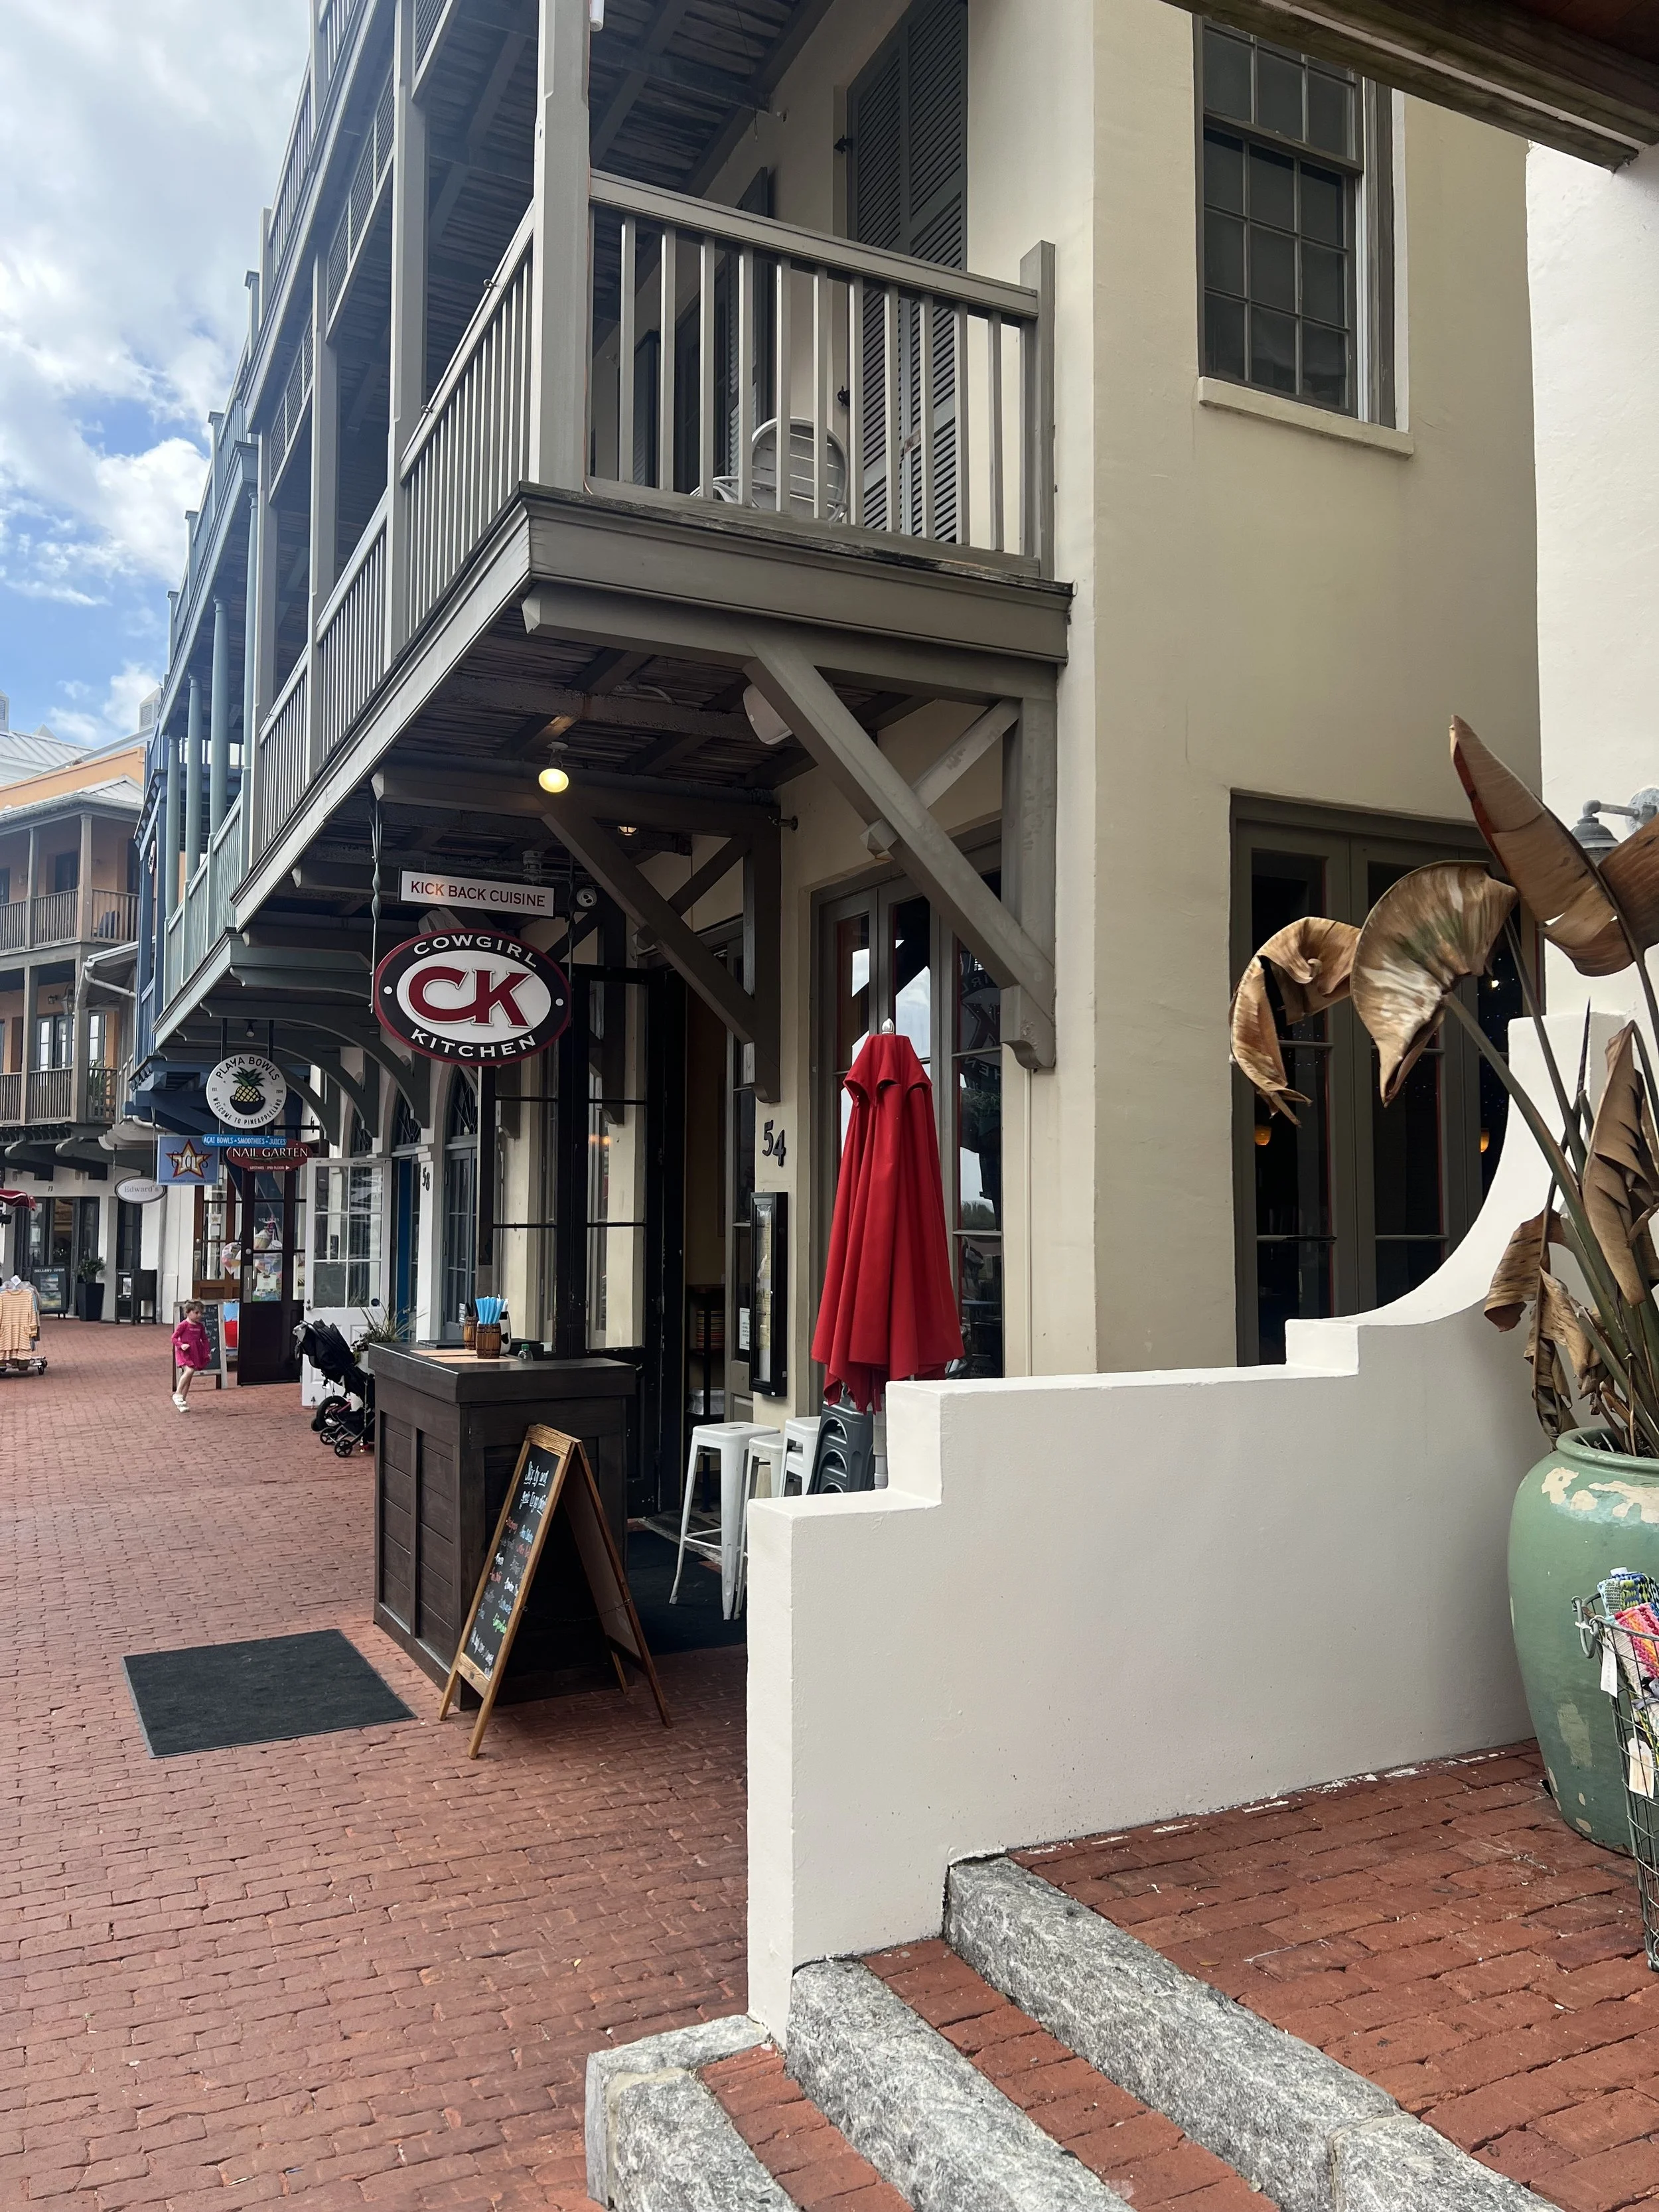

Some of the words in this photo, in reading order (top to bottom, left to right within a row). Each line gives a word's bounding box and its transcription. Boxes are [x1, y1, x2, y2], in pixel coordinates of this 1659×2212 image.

[411, 881, 445, 897] KICK
[448, 885, 486, 901] BACK
[490, 890, 545, 907] CUISINE
[413, 934, 537, 968] COWGIRL
[407, 965, 534, 1029] CK
[411, 1028, 536, 1058] KITCHEN
[216, 1057, 246, 1078] PLAYA
[248, 1057, 279, 1080] BOWLS
[213, 1097, 232, 1120] WELCOME
[244, 1098, 282, 1125] PINEAPPLELAND
[232, 1147, 258, 1157] NAIL
[261, 1147, 308, 1157] GARTEN
[762, 1119, 786, 1166] 54
[422, 1167, 430, 1191] 58
